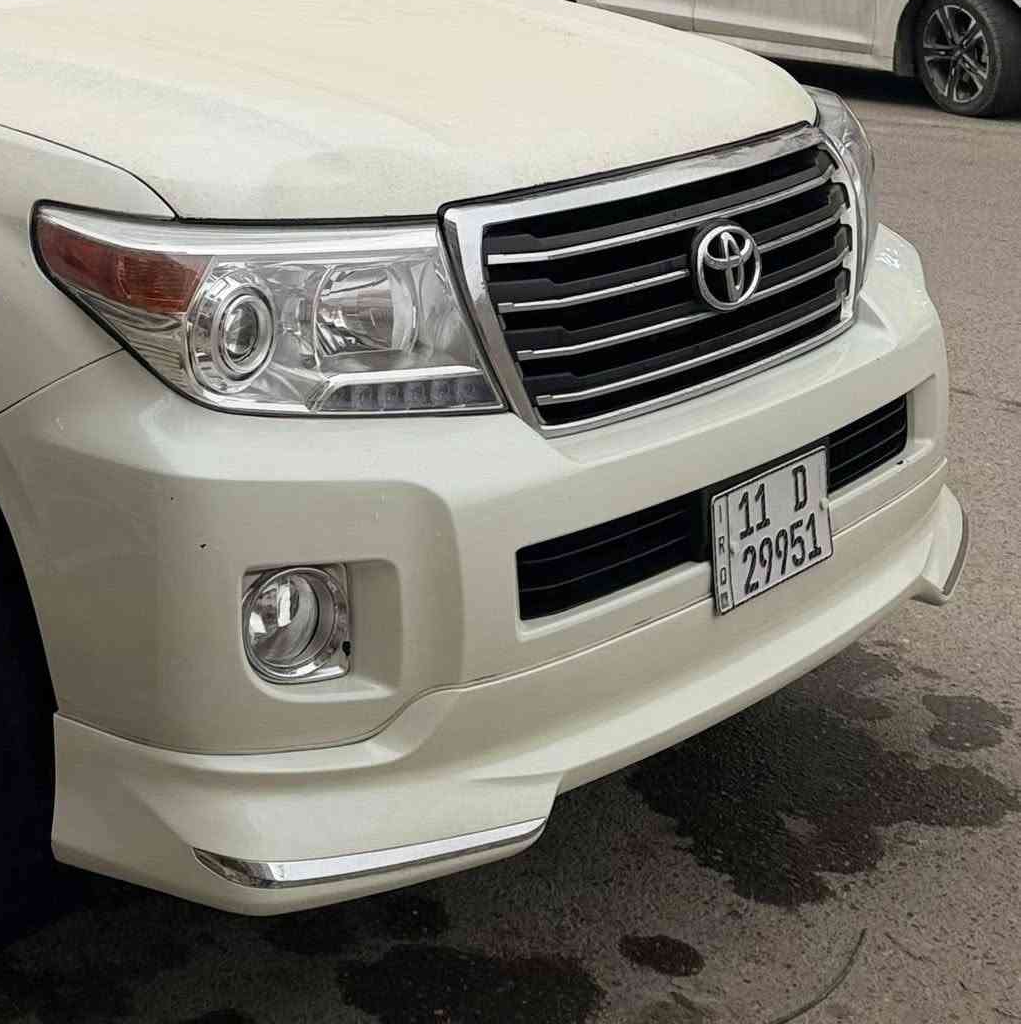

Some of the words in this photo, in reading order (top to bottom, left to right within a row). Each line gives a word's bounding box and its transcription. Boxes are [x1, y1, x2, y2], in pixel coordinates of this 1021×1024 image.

[739, 483, 771, 540] 11
[792, 464, 808, 512] D
[742, 512, 822, 595] 29951
